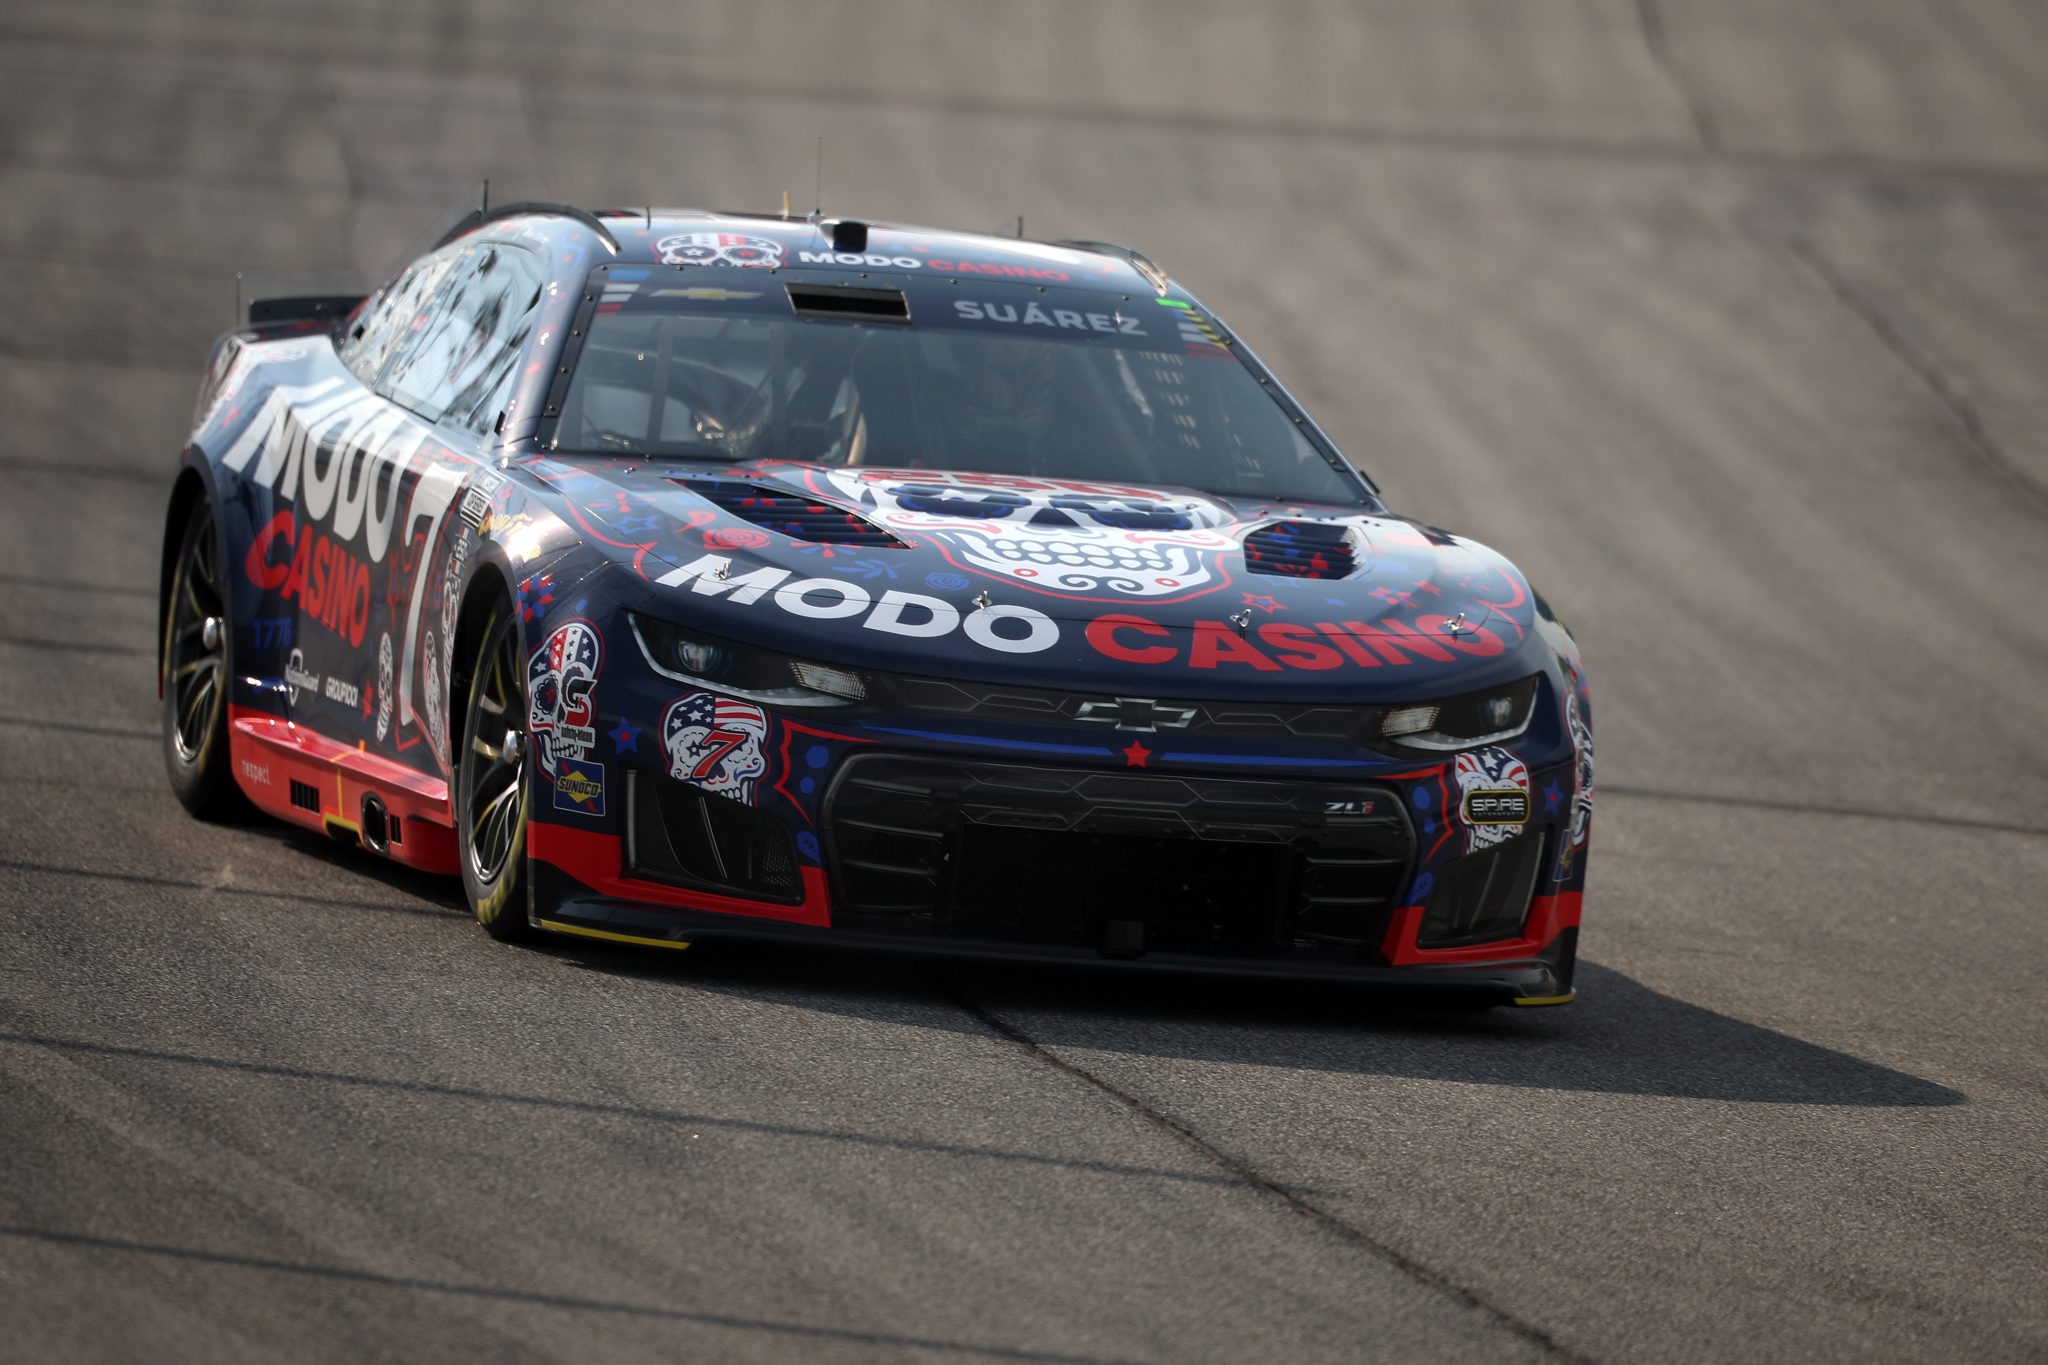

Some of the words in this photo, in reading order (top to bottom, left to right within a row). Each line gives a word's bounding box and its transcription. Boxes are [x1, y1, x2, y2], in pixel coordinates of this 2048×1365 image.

[799, 252, 922, 269] MODO
[928, 259, 1070, 281] CASINO
[954, 301, 1149, 336] SUÁREZ
[222, 376, 431, 564] MODO
[245, 510, 371, 649] CASINO
[400, 462, 468, 727] 7
[654, 553, 1060, 653] MODO
[1085, 614, 1505, 671] CASINO
[692, 729, 748, 779] 7
[558, 777, 600, 796] SUNOCO
[1323, 801, 1375, 814] ZL1
[1471, 798, 1525, 811] SPIRE
